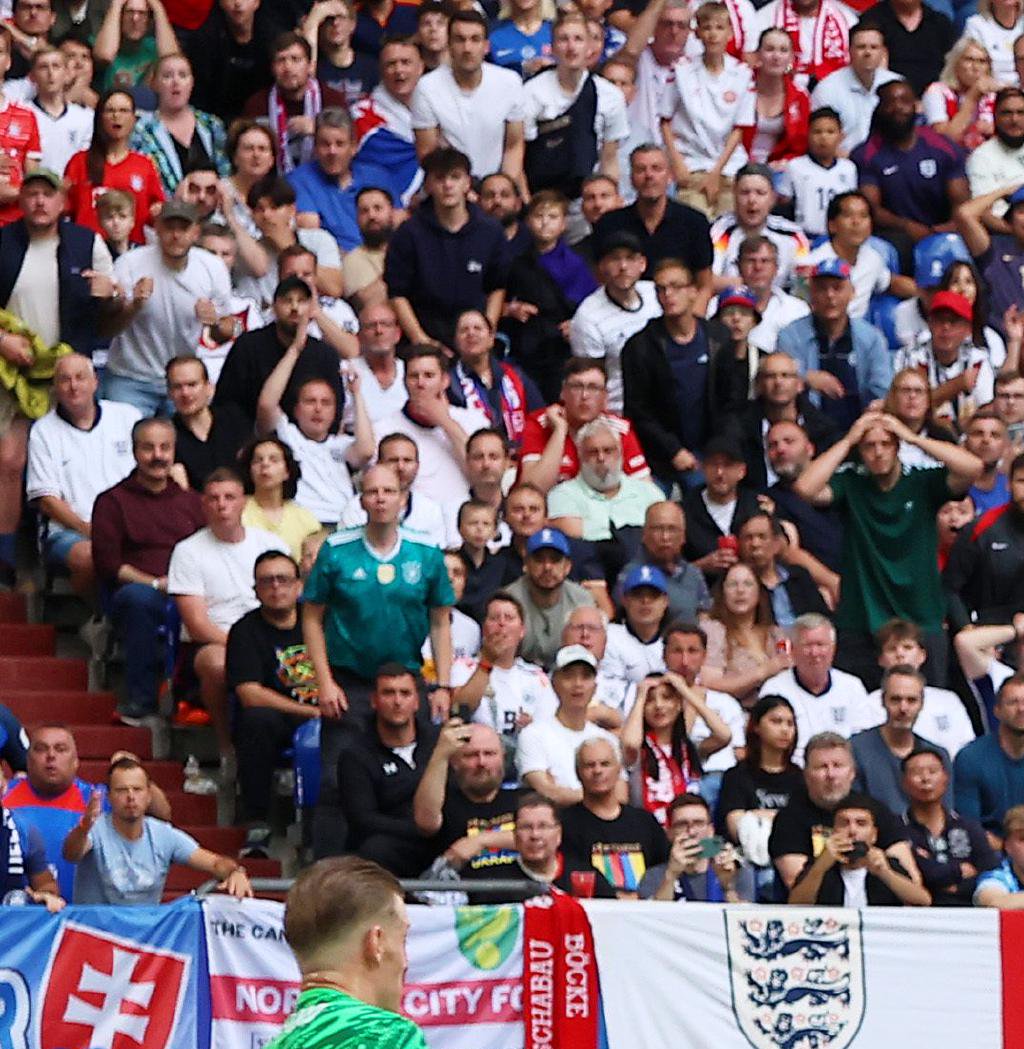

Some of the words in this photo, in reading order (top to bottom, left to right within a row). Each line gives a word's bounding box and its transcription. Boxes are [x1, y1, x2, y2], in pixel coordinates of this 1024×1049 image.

[210, 920, 247, 938] THE
[235, 983, 302, 1016] NOR
[403, 986, 485, 1017] CITY
